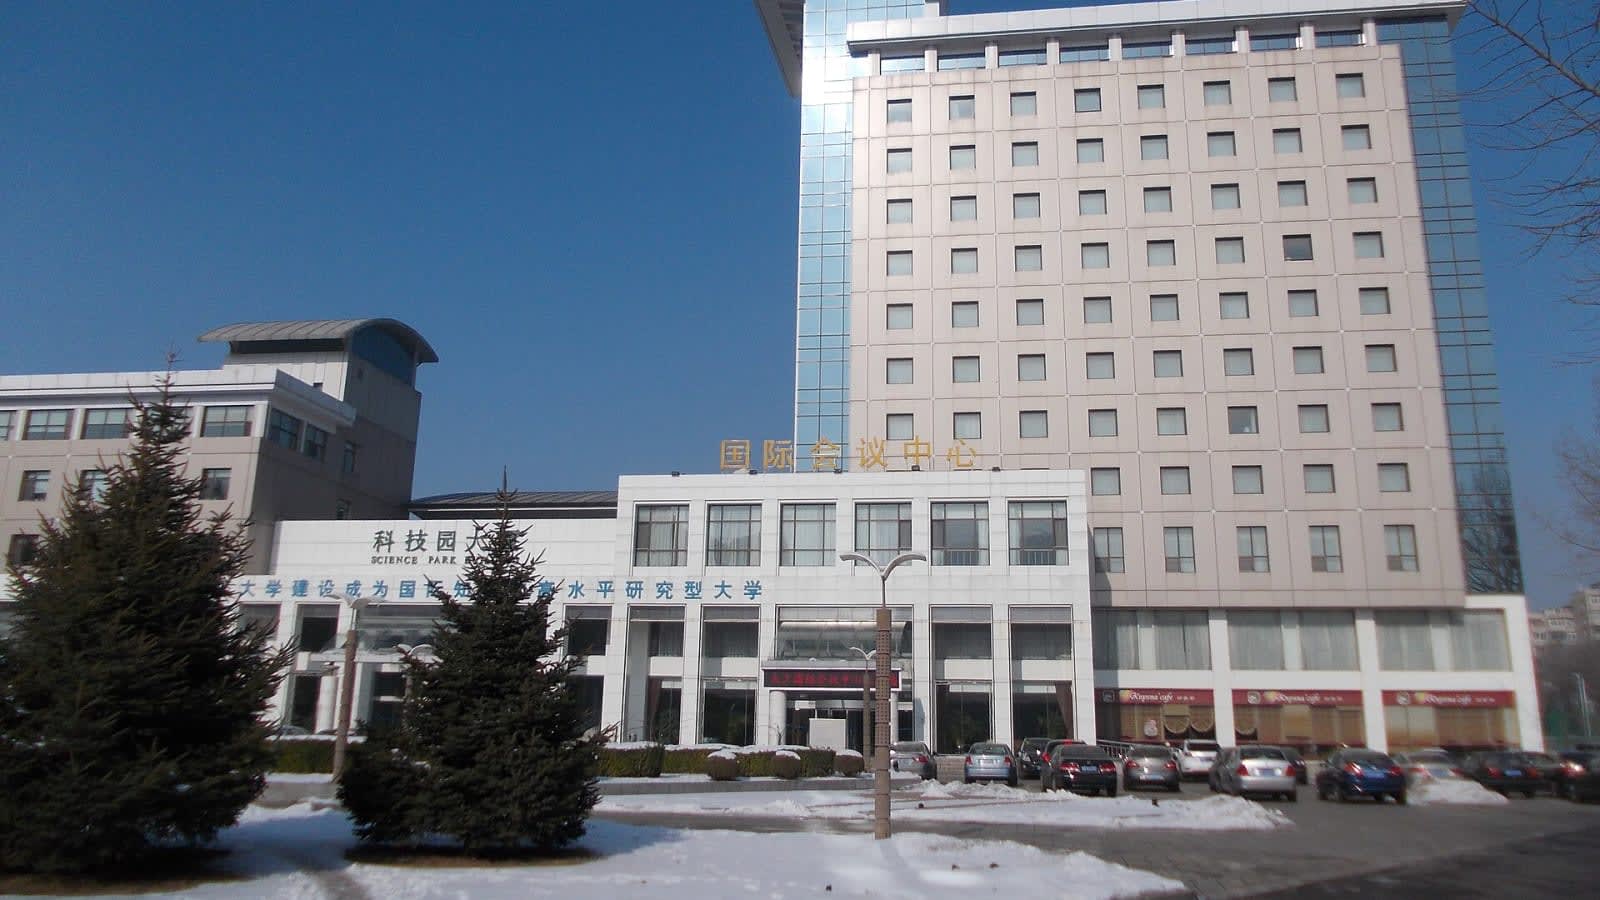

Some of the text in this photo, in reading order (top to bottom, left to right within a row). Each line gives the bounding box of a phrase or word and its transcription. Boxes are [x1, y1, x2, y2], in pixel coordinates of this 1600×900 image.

[720, 435, 977, 471] 国际会议中心
[372, 529, 521, 553] 科技园大
[371, 555, 418, 565] SCIENCE
[428, 555, 457, 565] PARK
